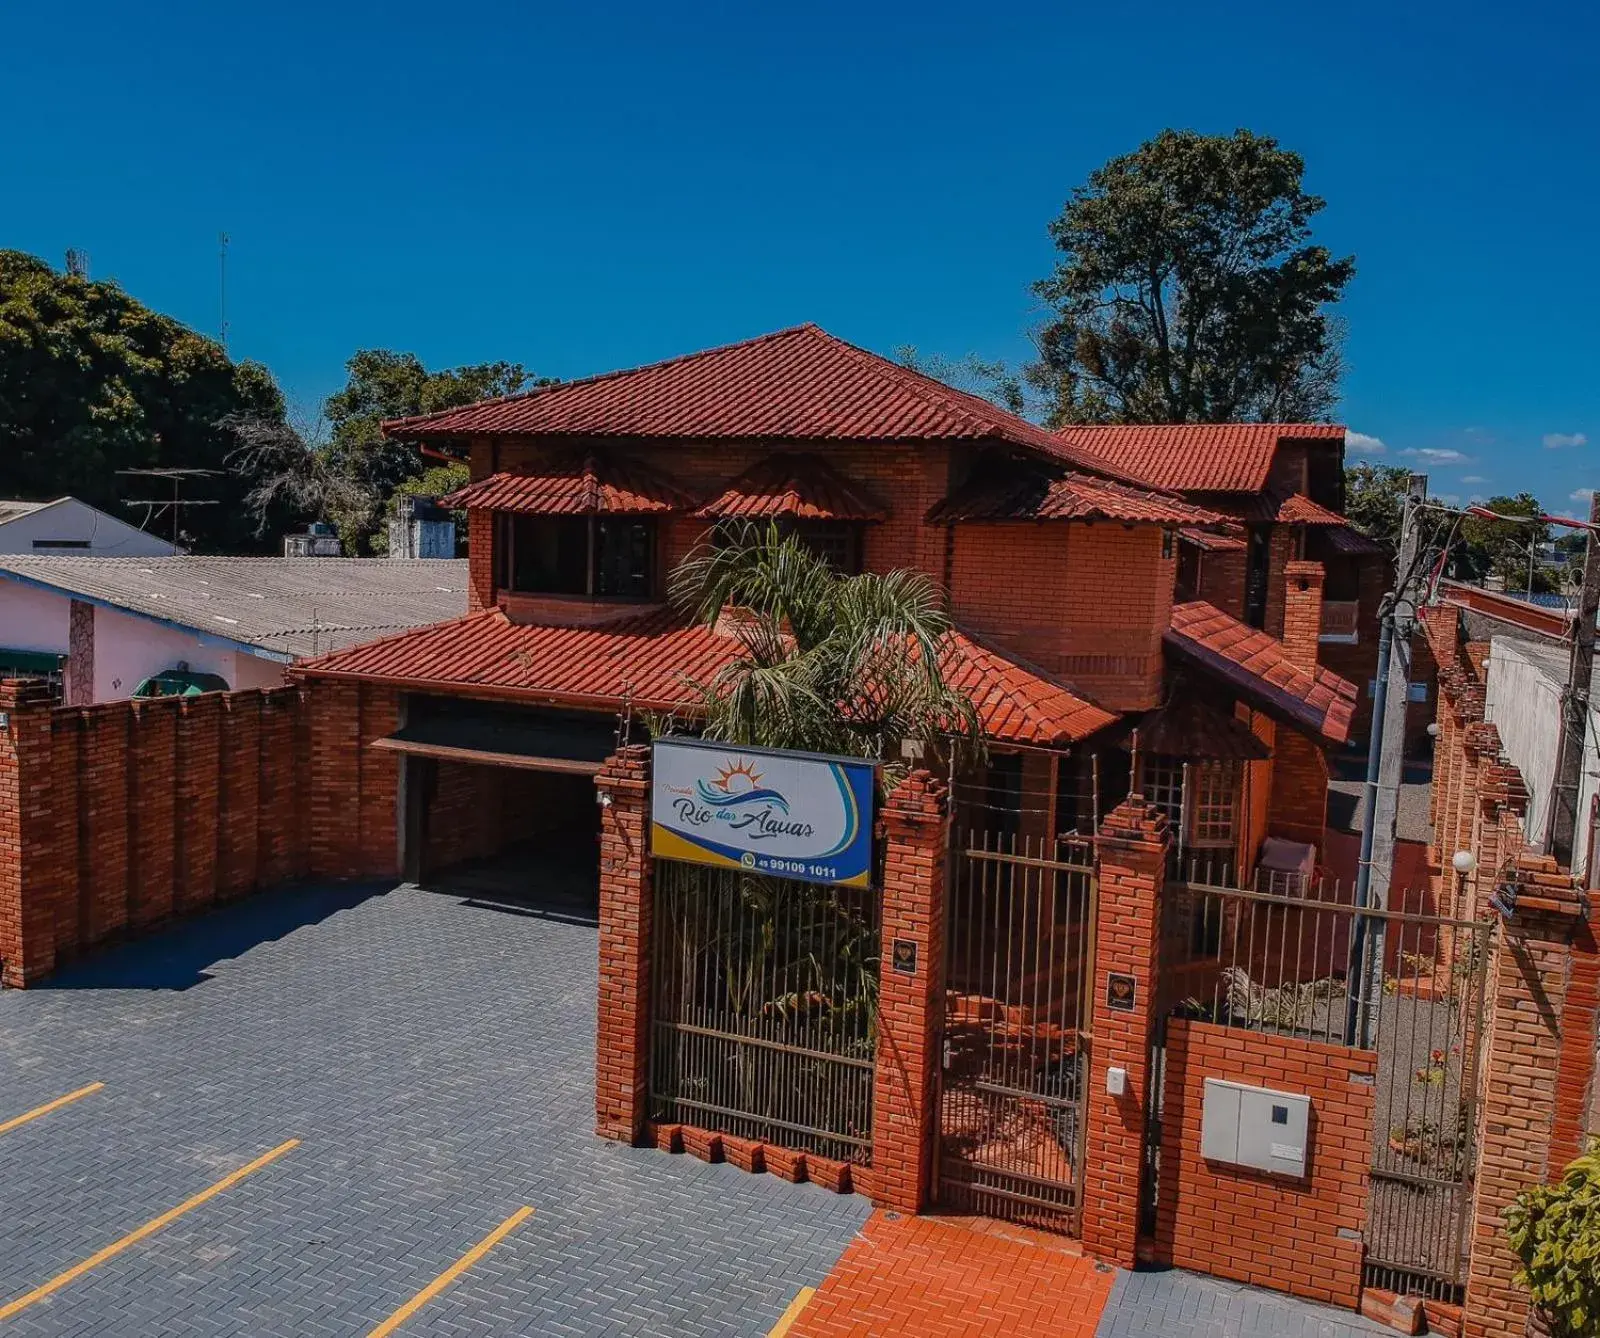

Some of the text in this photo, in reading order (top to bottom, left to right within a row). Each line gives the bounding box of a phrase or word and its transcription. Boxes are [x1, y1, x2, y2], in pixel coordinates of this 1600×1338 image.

[673, 798, 713, 826] Rio
[716, 807, 736, 821] das
[770, 859, 805, 873] 99109
[809, 865, 836, 878] 1011
